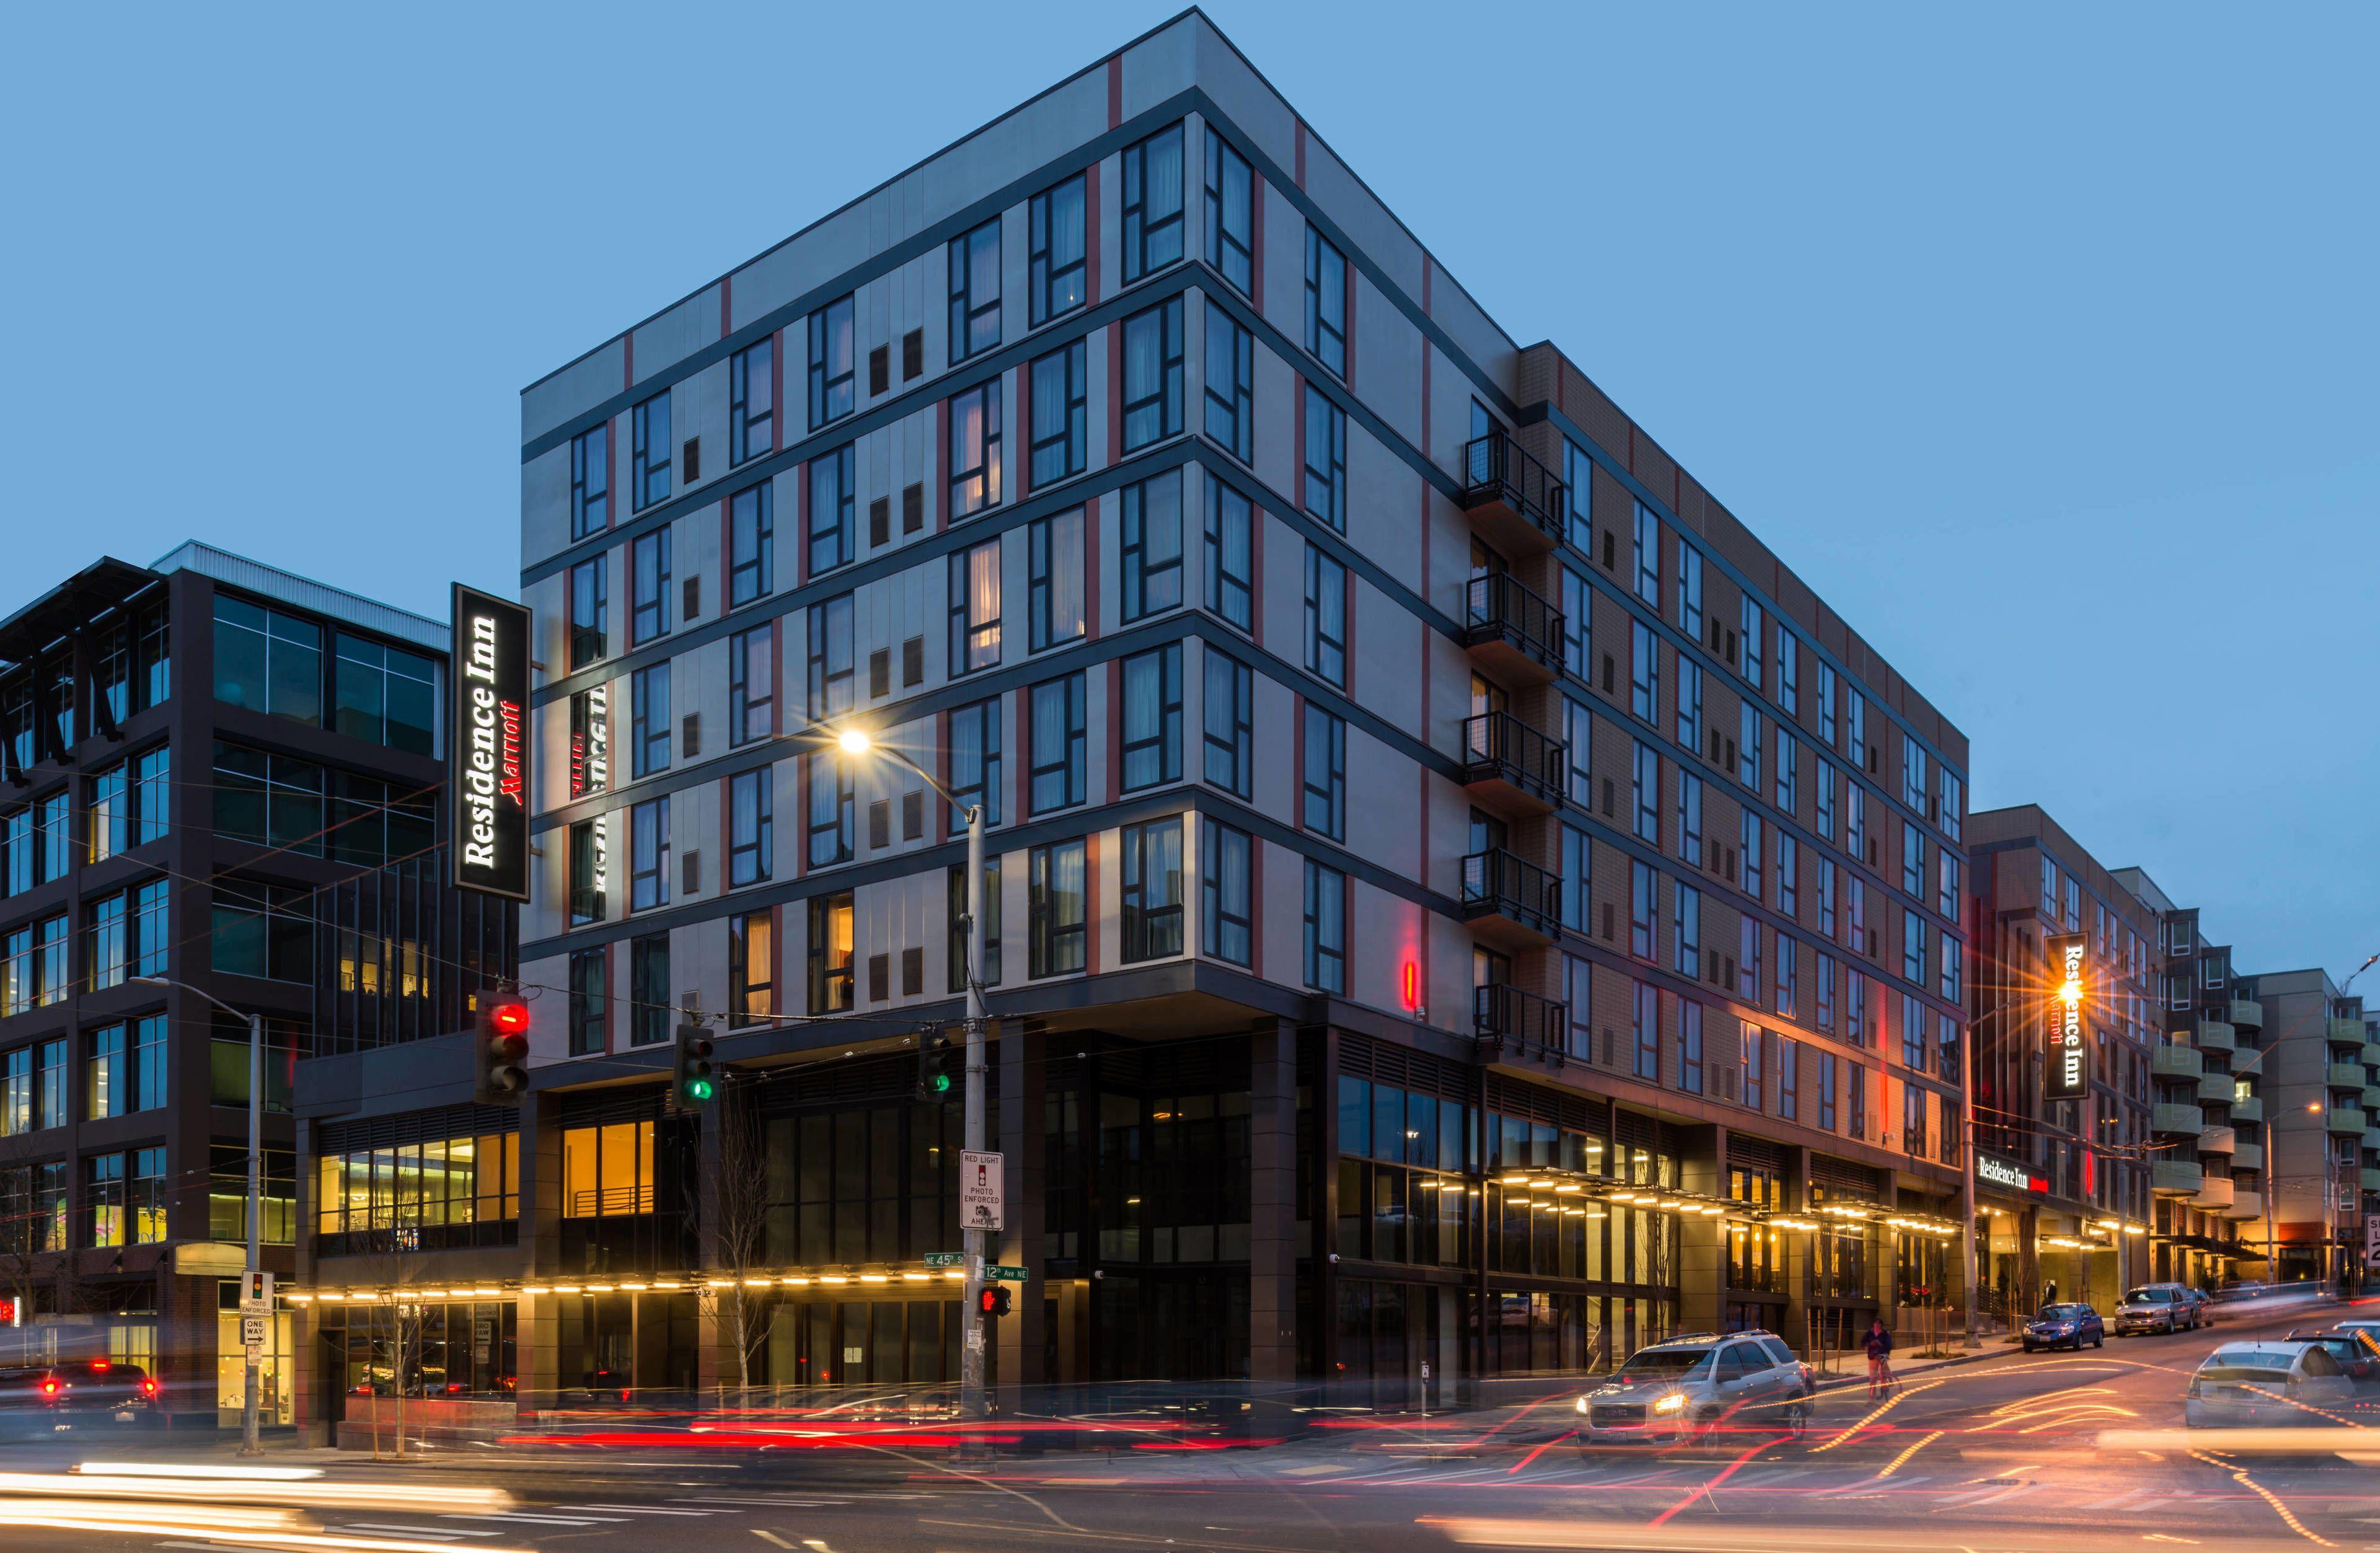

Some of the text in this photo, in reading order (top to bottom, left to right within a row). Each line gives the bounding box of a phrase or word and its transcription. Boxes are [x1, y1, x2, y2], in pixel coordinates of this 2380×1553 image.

[465, 616, 495, 869] Residence Inn
[500, 700, 522, 806] Marriott
[2065, 1049, 2082, 1087] Inn
[1979, 1156, 2014, 1185] Residence
[2014, 1168, 2028, 1189] Inn
[964, 1195, 999, 1203] ENFORCED
[926, 1257, 935, 1265] NE
